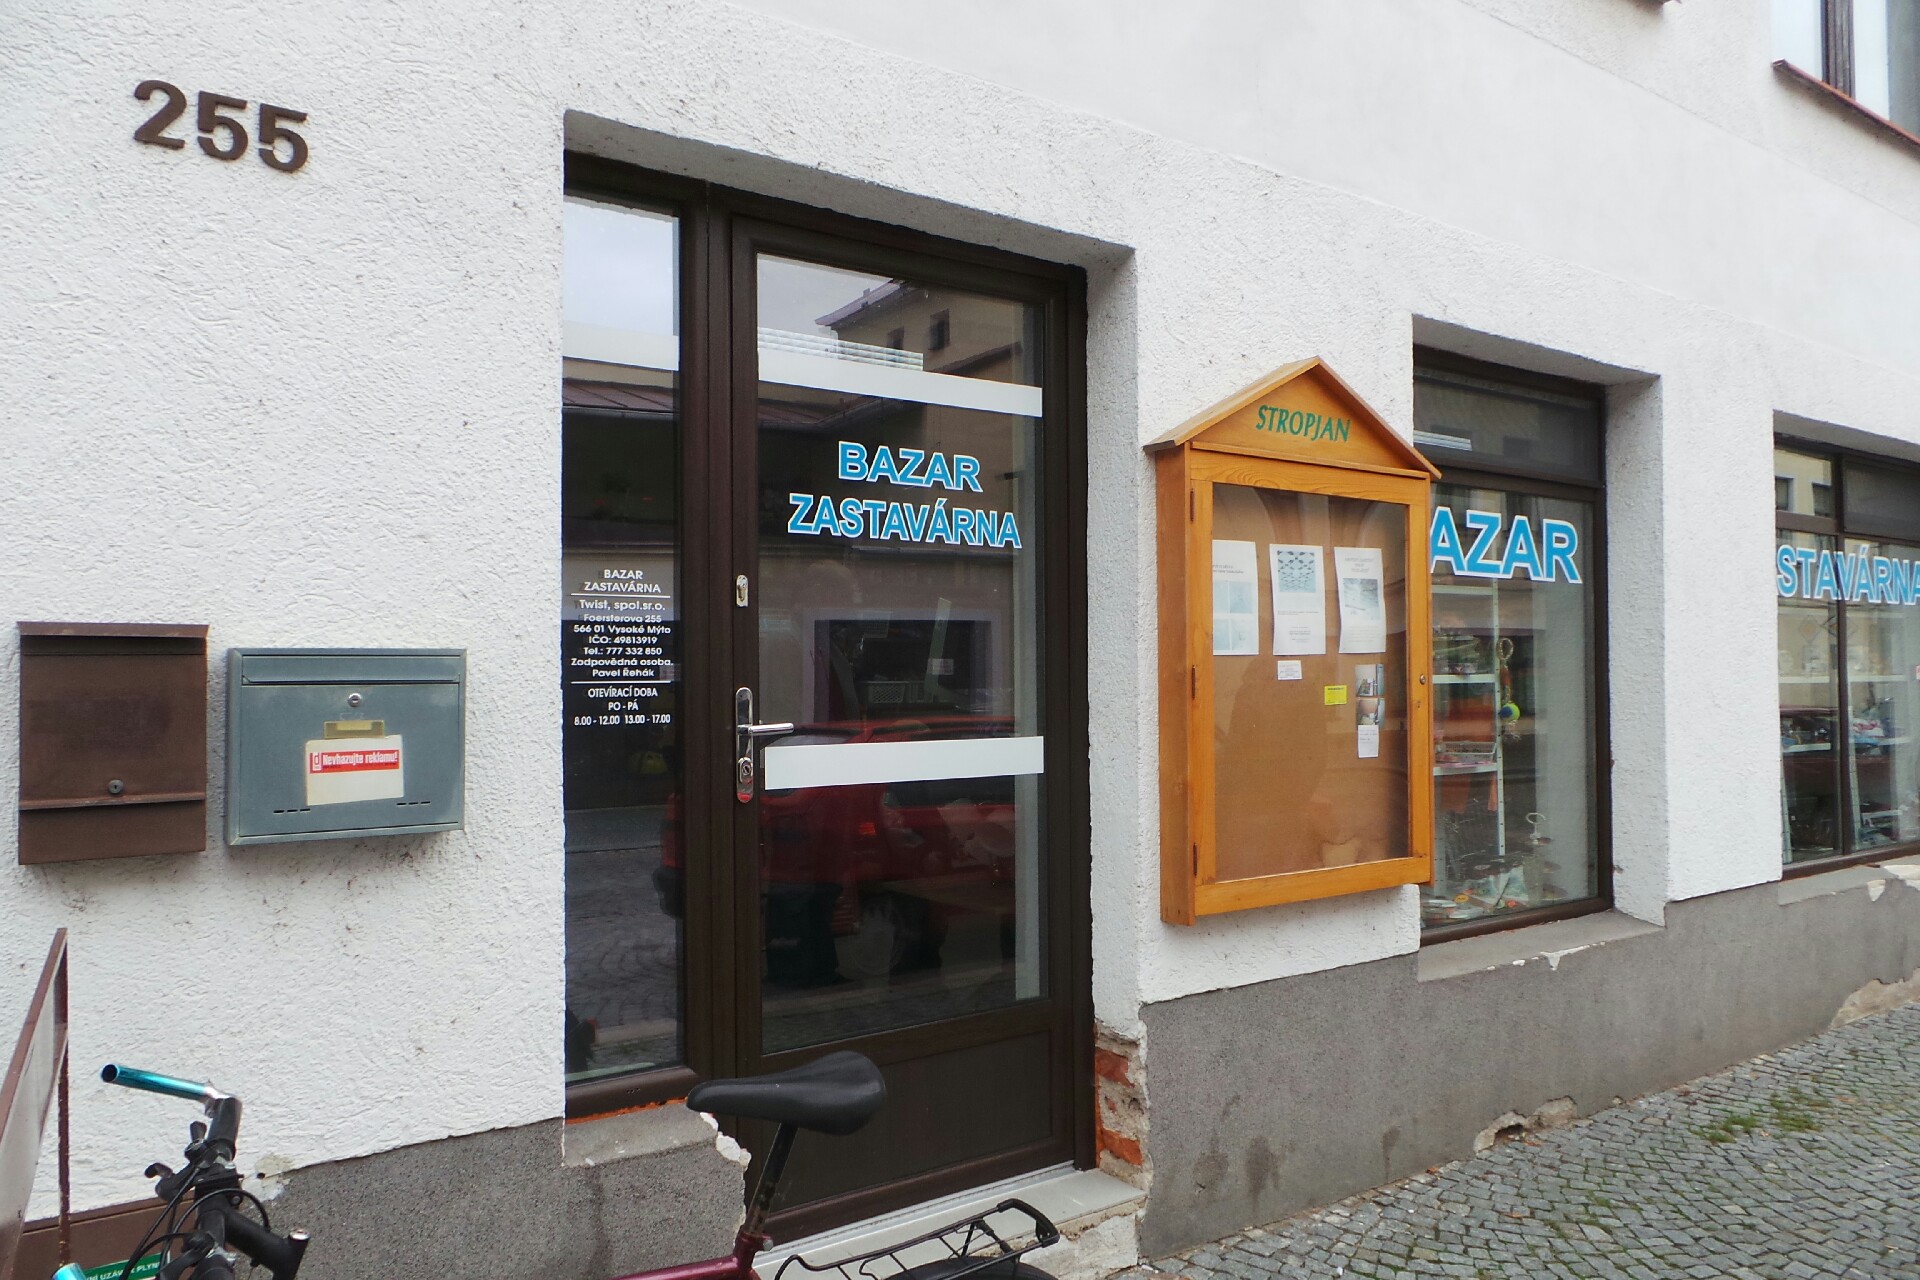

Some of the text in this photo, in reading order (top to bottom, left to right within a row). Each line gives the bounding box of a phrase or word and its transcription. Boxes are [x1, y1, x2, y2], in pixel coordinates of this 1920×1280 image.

[134, 80, 309, 173] 255
[1255, 404, 1351, 442] STROPJAN
[838, 440, 984, 493] BAZAR
[788, 493, 1022, 549] ZASTAVÁRNA
[604, 569, 643, 580] BAZAR
[584, 580, 661, 593] ZASTAVÁRNA
[579, 599, 611, 611] Twist,
[583, 614, 662, 623] Foersterova 255
[573, 625, 671, 636] 566 01 Vysoké Mýto
[588, 635, 658, 644] IČO: 49813919
[605, 647, 623, 655] 777
[625, 647, 644, 655] 332
[645, 647, 663, 655] 850
[570, 658, 638, 667] Zodpovědná
[592, 667, 655, 677] Pavel Řehák
[588, 685, 659, 698] OTEVÍRACÍ DOBA
[608, 701, 621, 711] PO
[627, 699, 639, 711] PÁ
[574, 716, 592, 726] 8.00
[599, 715, 621, 725] 12.00
[624, 714, 646, 724] 13.00
[652, 714, 671, 724] 17.00
[322, 751, 398, 766] Nevhazujte reklamu!
